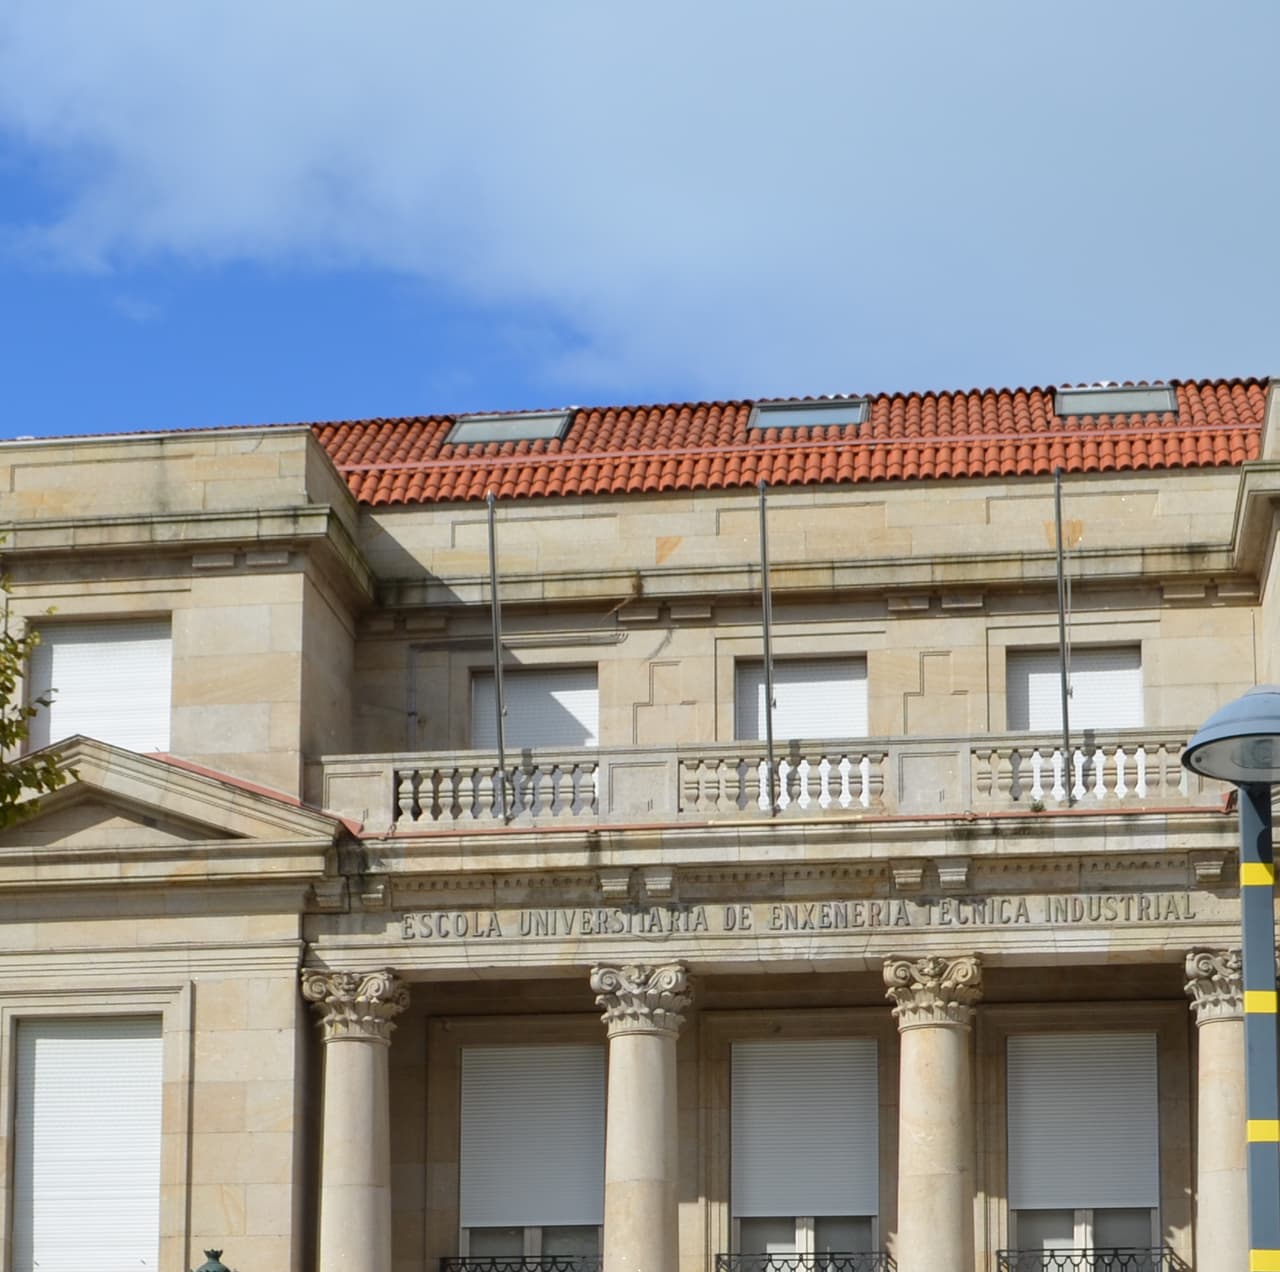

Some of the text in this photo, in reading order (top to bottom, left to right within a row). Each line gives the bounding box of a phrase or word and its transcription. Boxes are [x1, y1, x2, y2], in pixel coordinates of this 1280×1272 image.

[401, 911, 502, 940] ESCOLA
[519, 905, 709, 938] UNIVERSITARIA
[723, 904, 752, 931] DE
[1045, 893, 1197, 922] INDUSTRIAL
